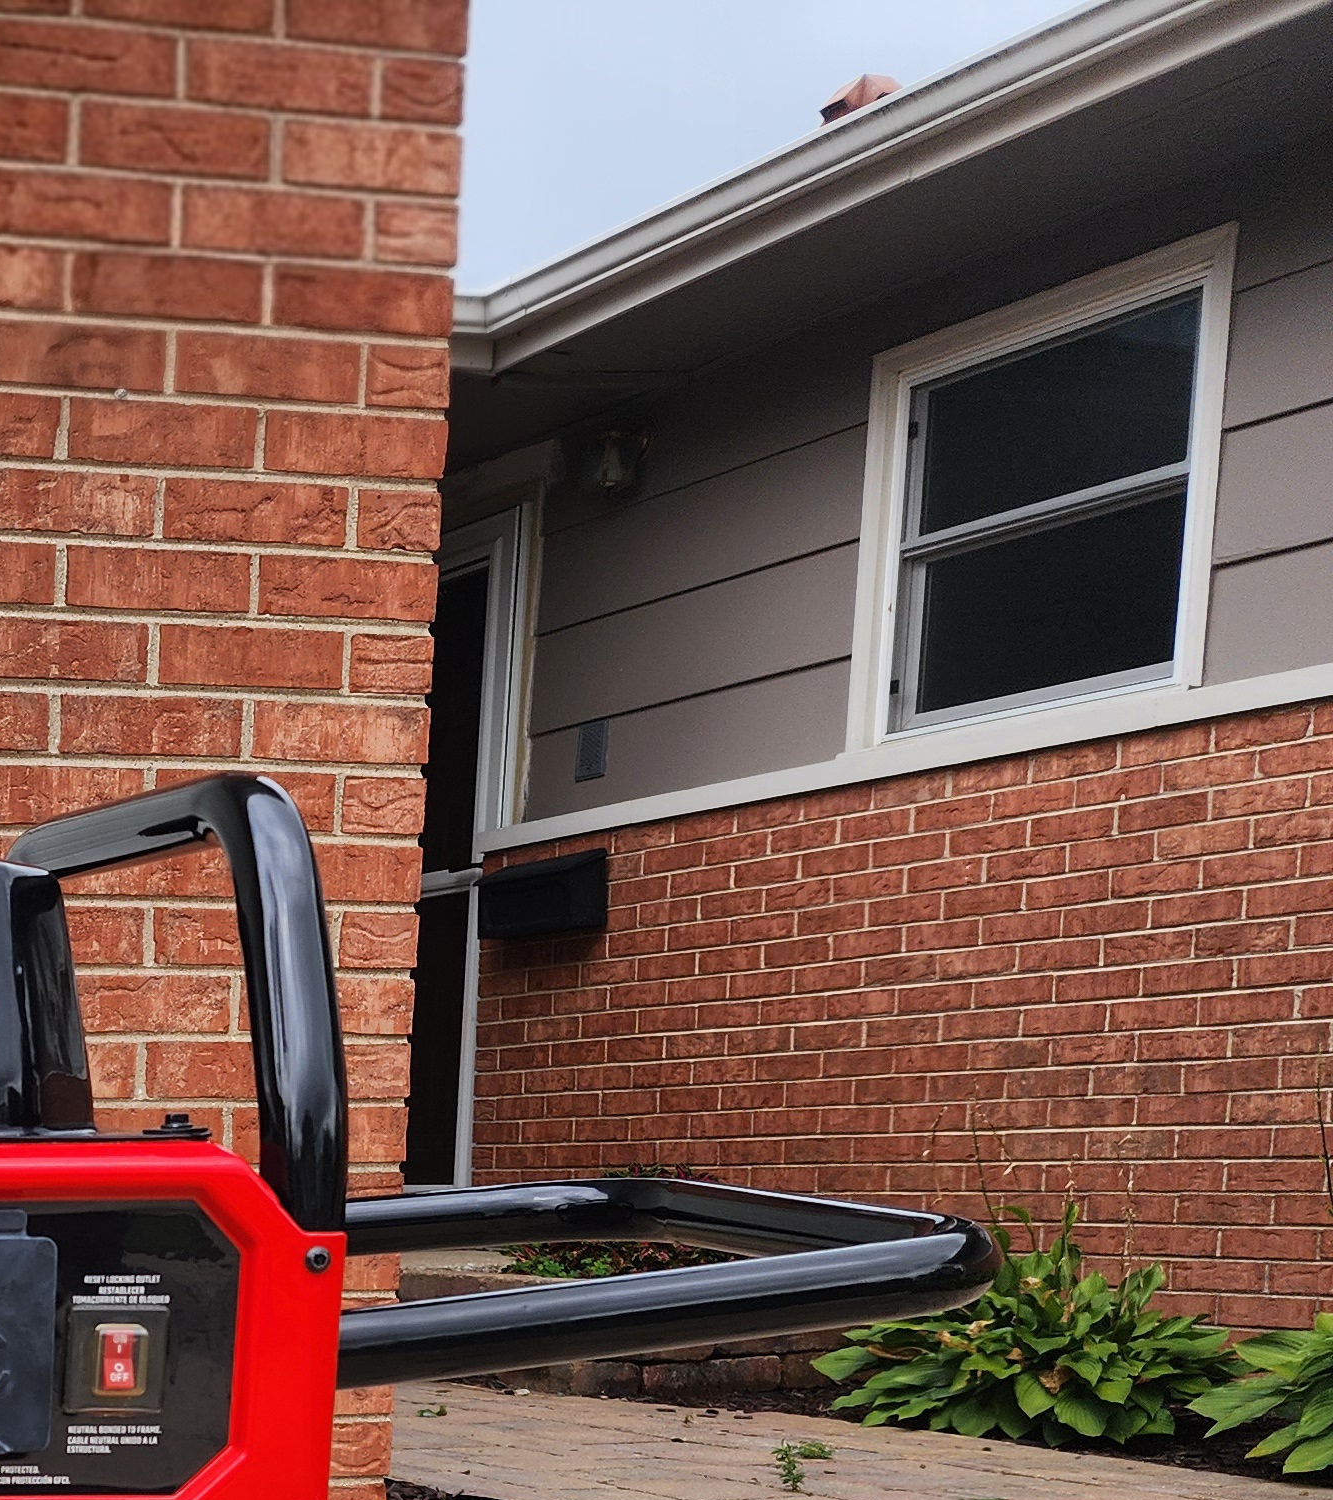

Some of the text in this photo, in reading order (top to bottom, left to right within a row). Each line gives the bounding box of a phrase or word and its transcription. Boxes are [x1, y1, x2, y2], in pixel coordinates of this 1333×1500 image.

[110, 1372, 129, 1382] OFF
[68, 1425, 97, 1434] NEUTRAL
[128, 1425, 136, 1434] TO
[67, 1436, 88, 1444] CABLE
[149, 1436, 157, 1445] LA
